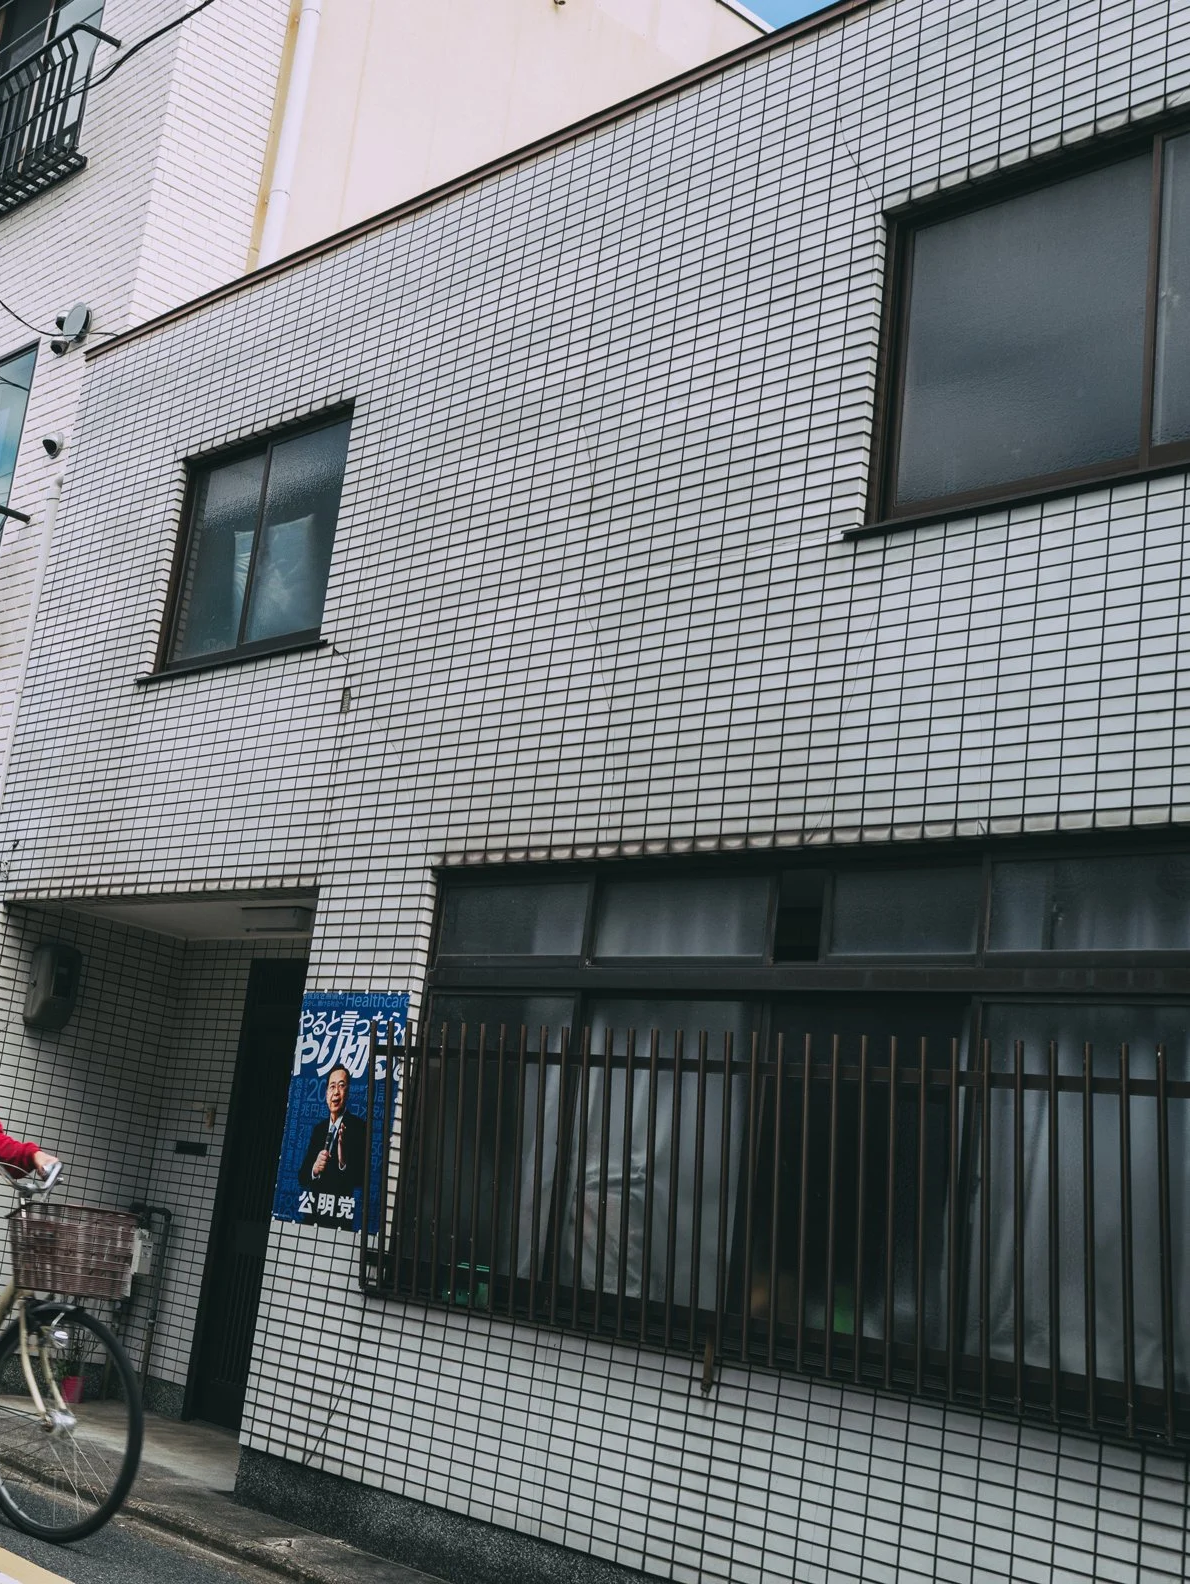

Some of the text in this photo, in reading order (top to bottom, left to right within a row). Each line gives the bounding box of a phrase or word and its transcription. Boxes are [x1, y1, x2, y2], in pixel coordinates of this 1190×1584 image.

[345, 993, 410, 1009] Healthcare
[298, 1190, 356, 1220] 公明党
